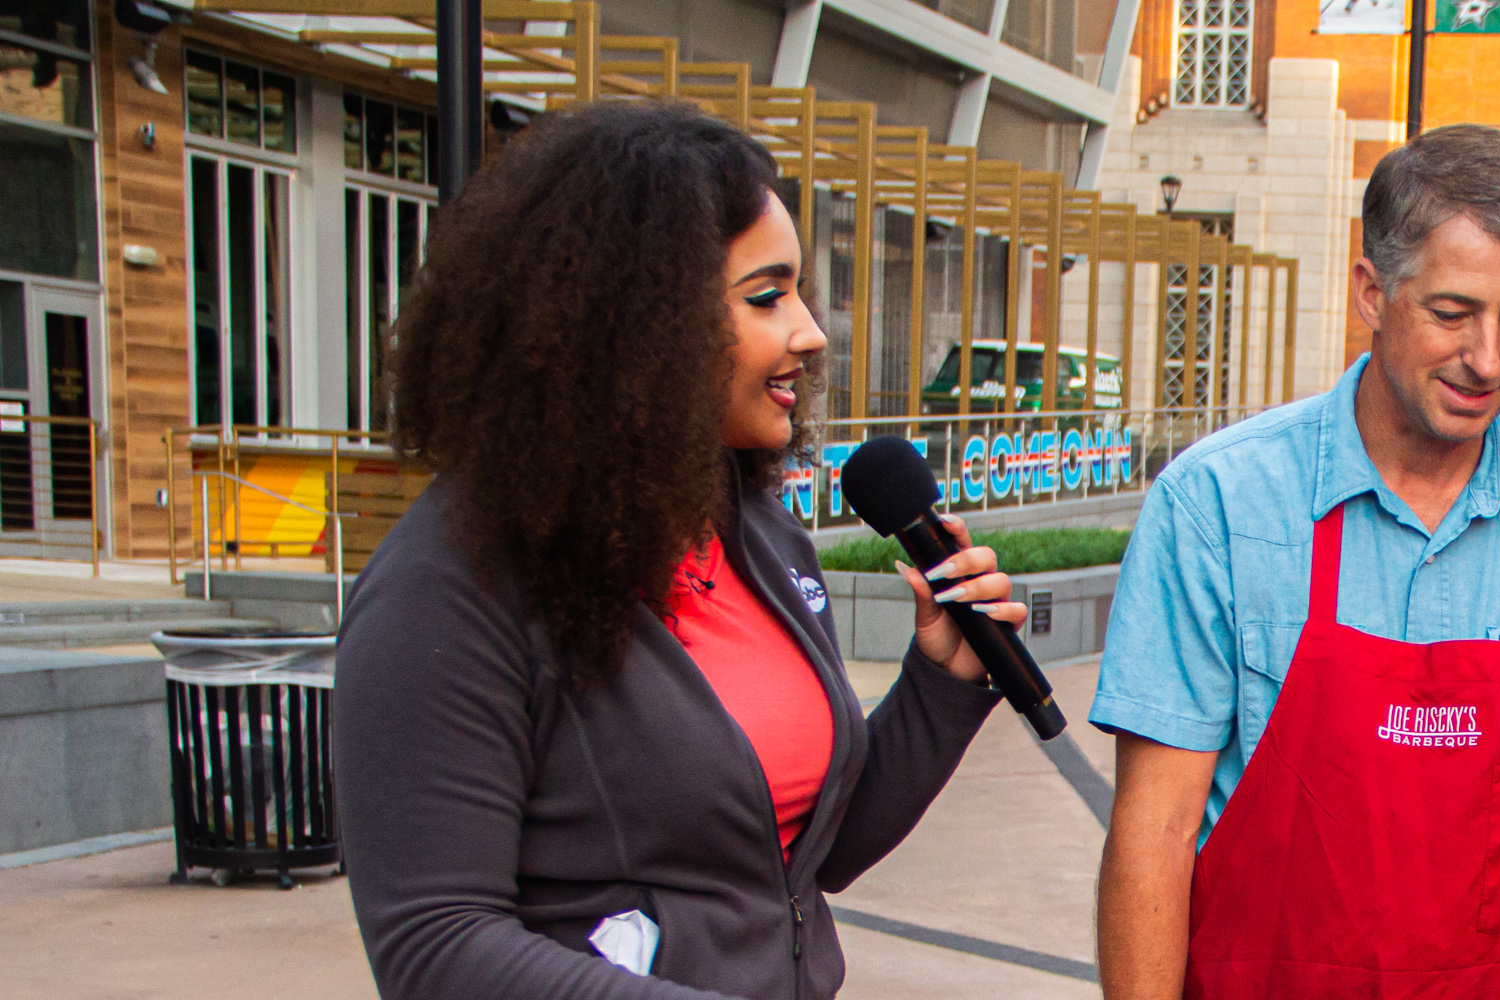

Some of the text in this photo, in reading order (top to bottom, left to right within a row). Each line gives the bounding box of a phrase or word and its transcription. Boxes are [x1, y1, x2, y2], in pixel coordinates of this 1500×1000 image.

[1378, 704, 1477, 738] JOE RISCKY'S
[1393, 733, 1478, 747] BARBEQUE
